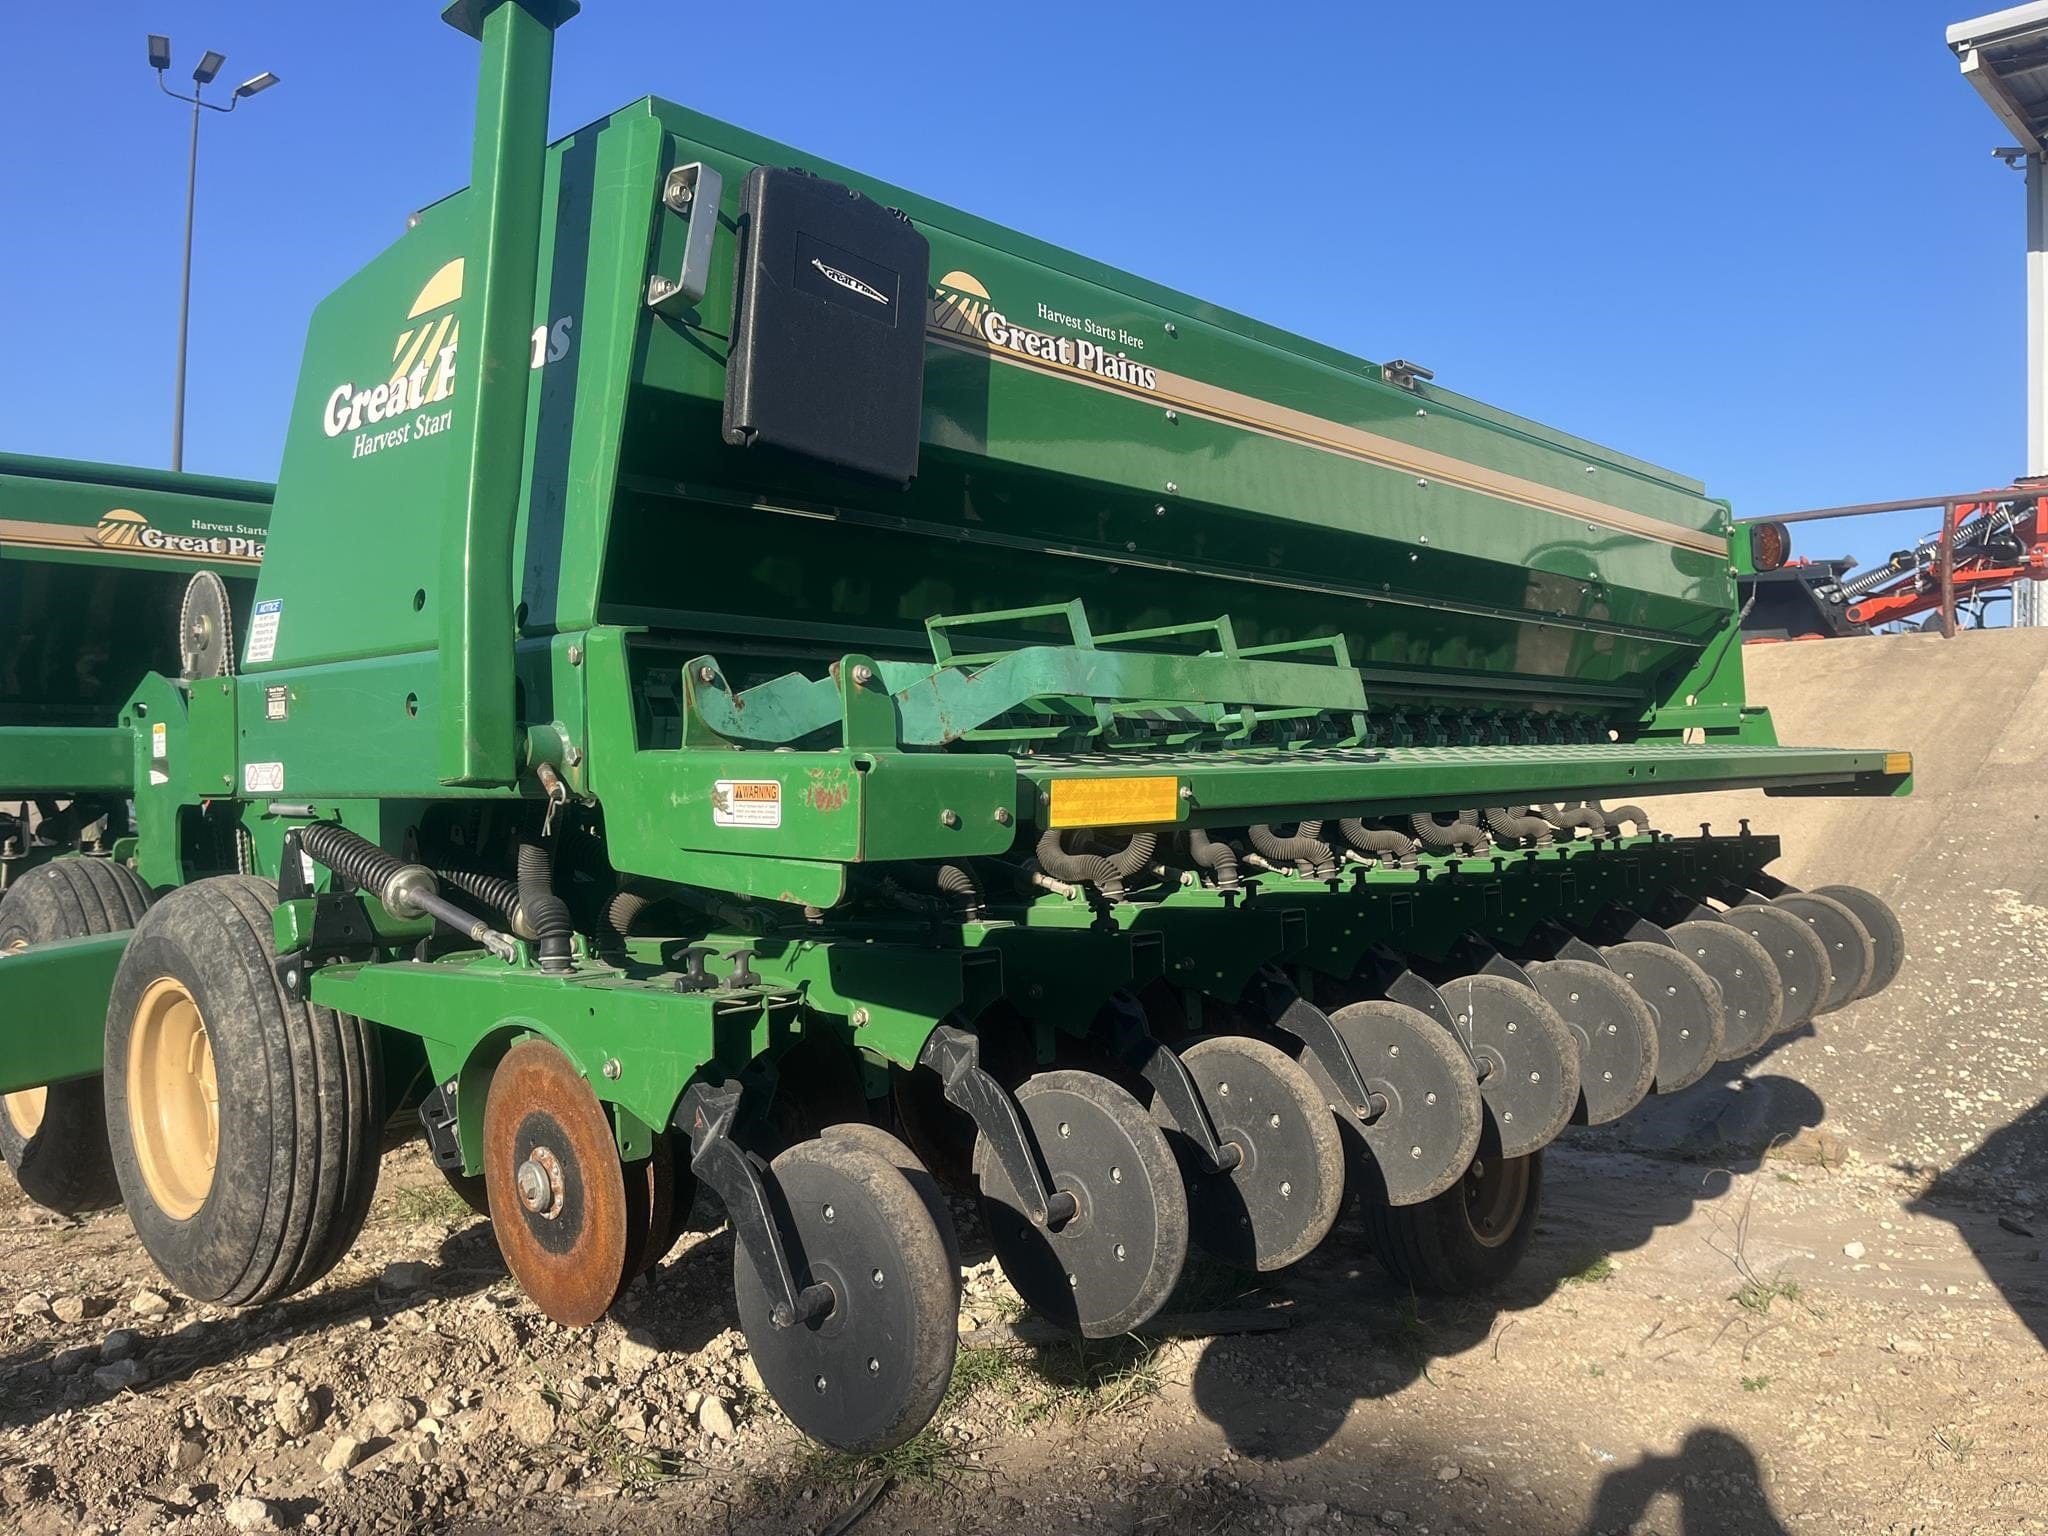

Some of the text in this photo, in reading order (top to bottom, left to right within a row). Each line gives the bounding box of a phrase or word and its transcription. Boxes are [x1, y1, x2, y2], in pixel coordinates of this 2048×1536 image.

[1038, 303, 1144, 350] Harvest Starts Here
[983, 311, 1157, 390] Great Plains
[323, 360, 430, 438] Great
[352, 423, 411, 459] Harvest
[141, 528, 222, 554] Great
[191, 519, 268, 536] Harvest Starts
[742, 785, 777, 799] WARNING
